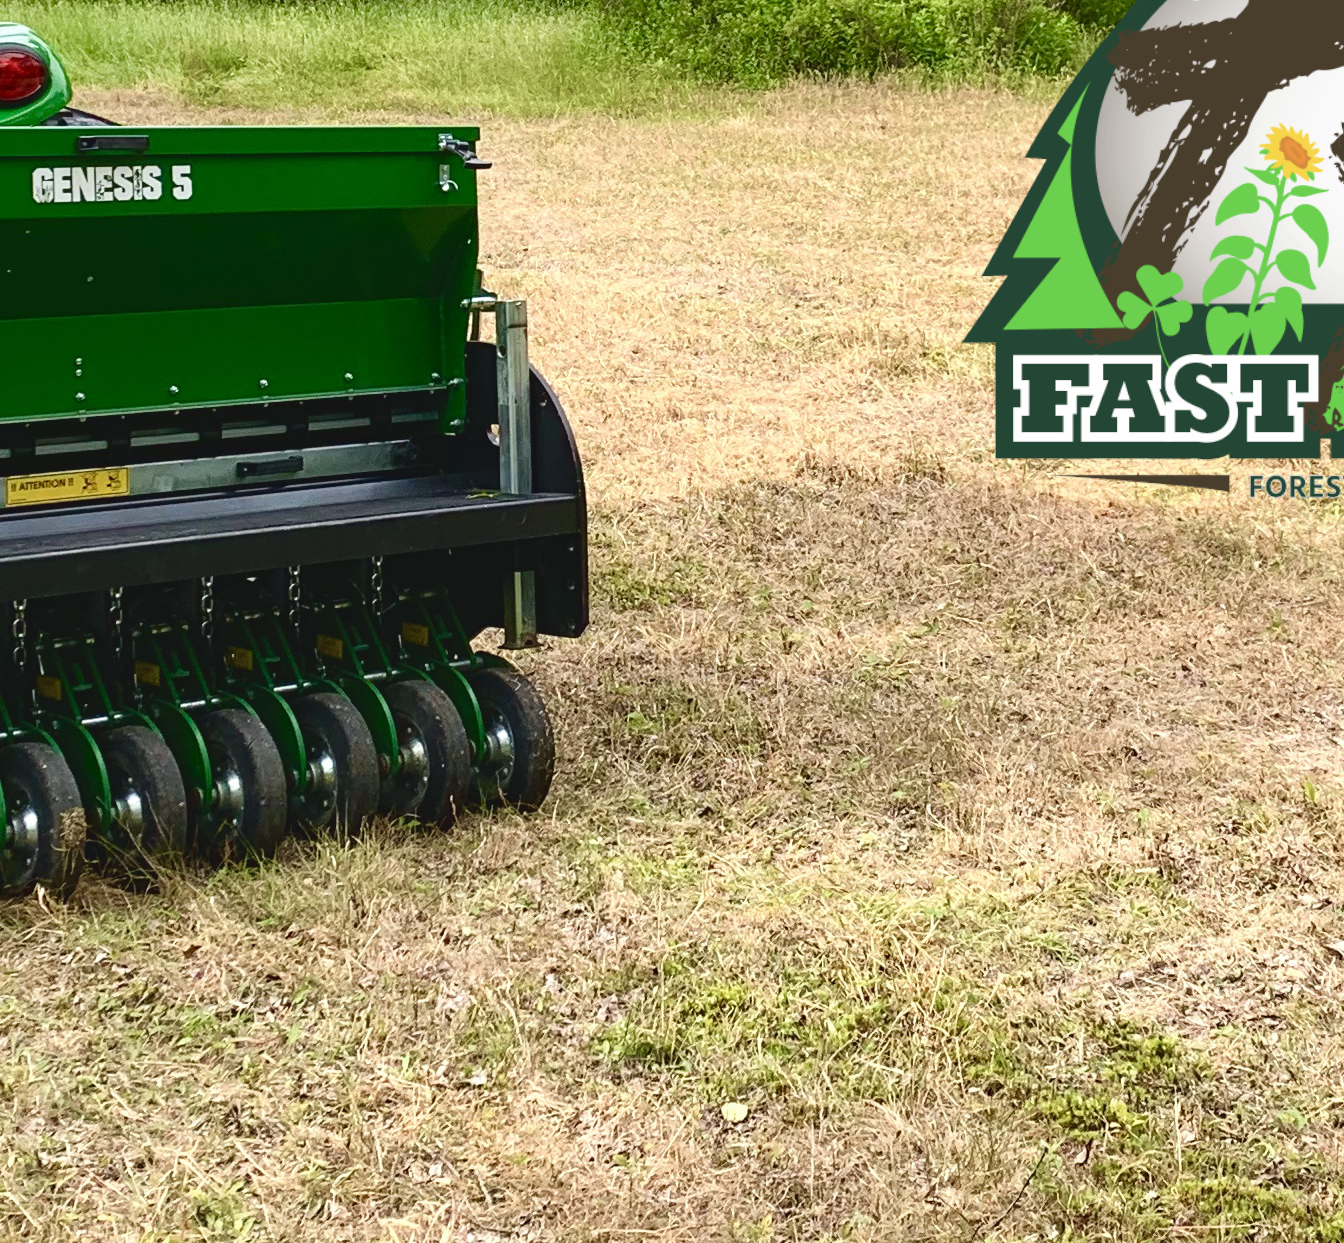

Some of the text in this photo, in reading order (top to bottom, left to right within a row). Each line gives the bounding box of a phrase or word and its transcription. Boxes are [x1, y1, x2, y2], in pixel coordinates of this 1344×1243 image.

[32, 165, 193, 203] GENESIS 5
[19, 478, 67, 491] ATTENTION
